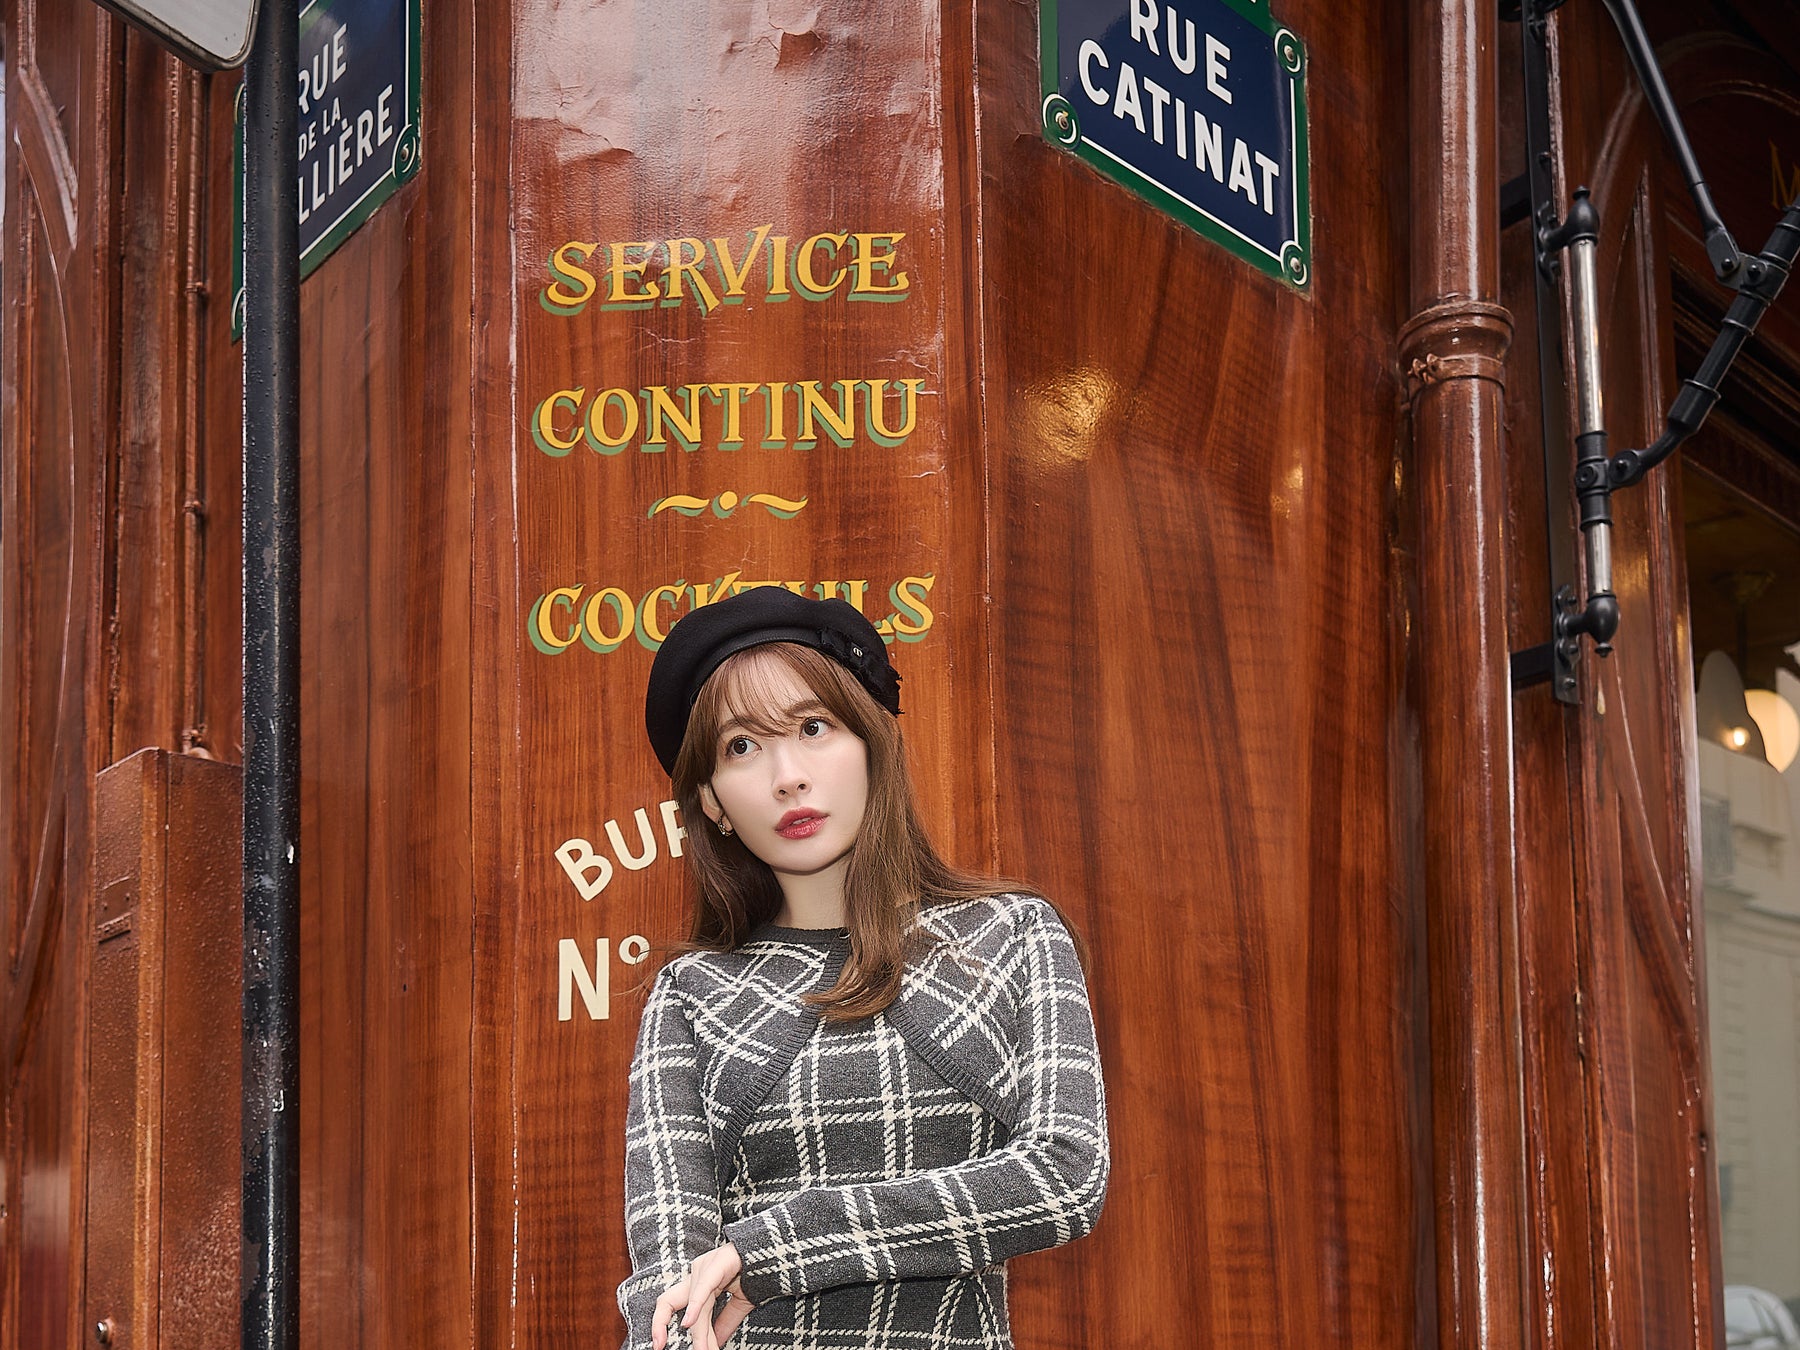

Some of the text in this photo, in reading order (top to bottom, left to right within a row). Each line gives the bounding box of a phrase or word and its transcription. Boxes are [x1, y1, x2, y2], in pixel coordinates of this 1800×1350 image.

[1130, 0, 1232, 105] RUE
[299, 97, 341, 161] DE LA
[1078, 39, 1280, 216] CATINAT
[540, 224, 910, 317] SERVICE
[532, 378, 926, 458] CONTINU
